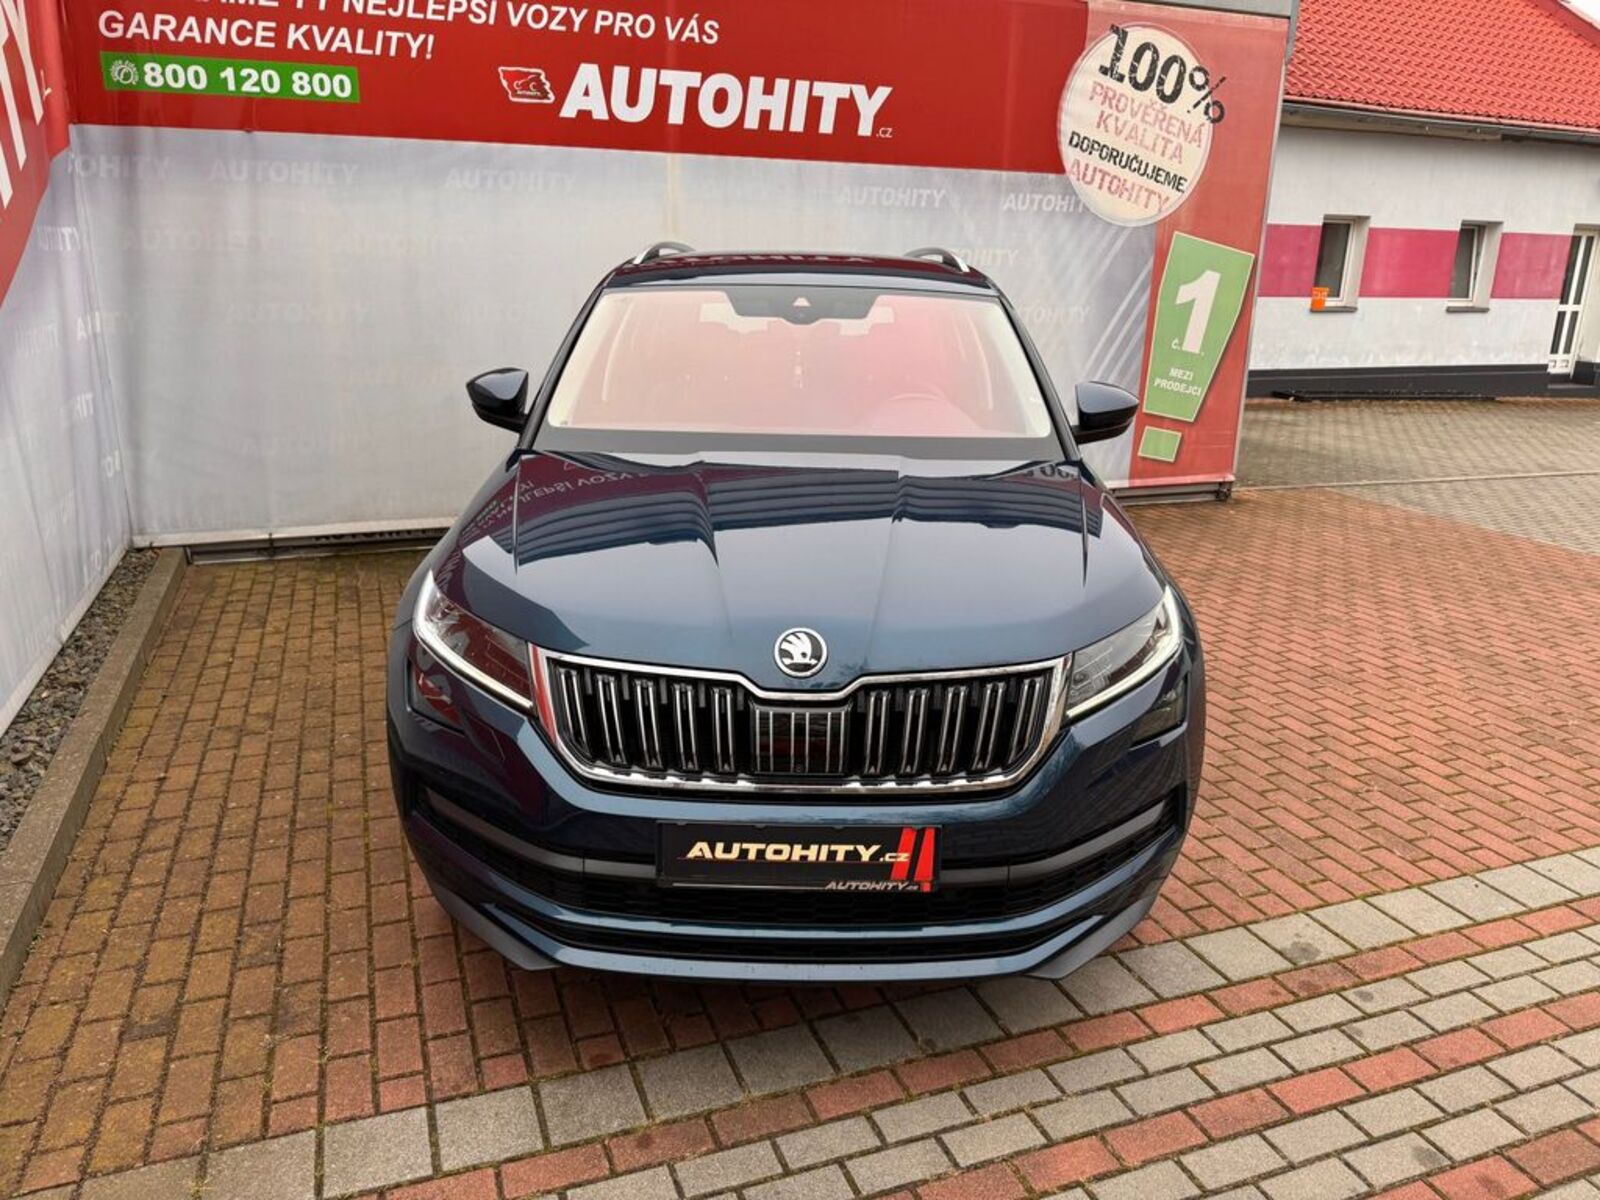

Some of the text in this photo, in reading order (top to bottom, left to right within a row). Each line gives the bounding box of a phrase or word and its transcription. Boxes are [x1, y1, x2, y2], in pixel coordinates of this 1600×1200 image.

[98, 10, 434, 59] GARANCE KVALITY!
[506, 1, 588, 33] VOZY
[594, 9, 656, 38] PRO
[664, 13, 720, 44] VÁS
[143, 62, 207, 90] 800
[220, 66, 281, 94] 120
[291, 71, 352, 98] 800
[1098, 24, 1226, 123] 100%
[1096, 110, 1183, 164] KVALITA
[209, 158, 360, 185] AUTOHITY
[445, 167, 577, 193] AUTOHITY
[1069, 131, 1188, 194] DOPORUČUJEME
[838, 187, 947, 208] AUTOHITY
[1069, 158, 1170, 213] AUTOHITY
[1154, 377, 1202, 397] PRODEJCI
[1169, 367, 1194, 381] MEZI
